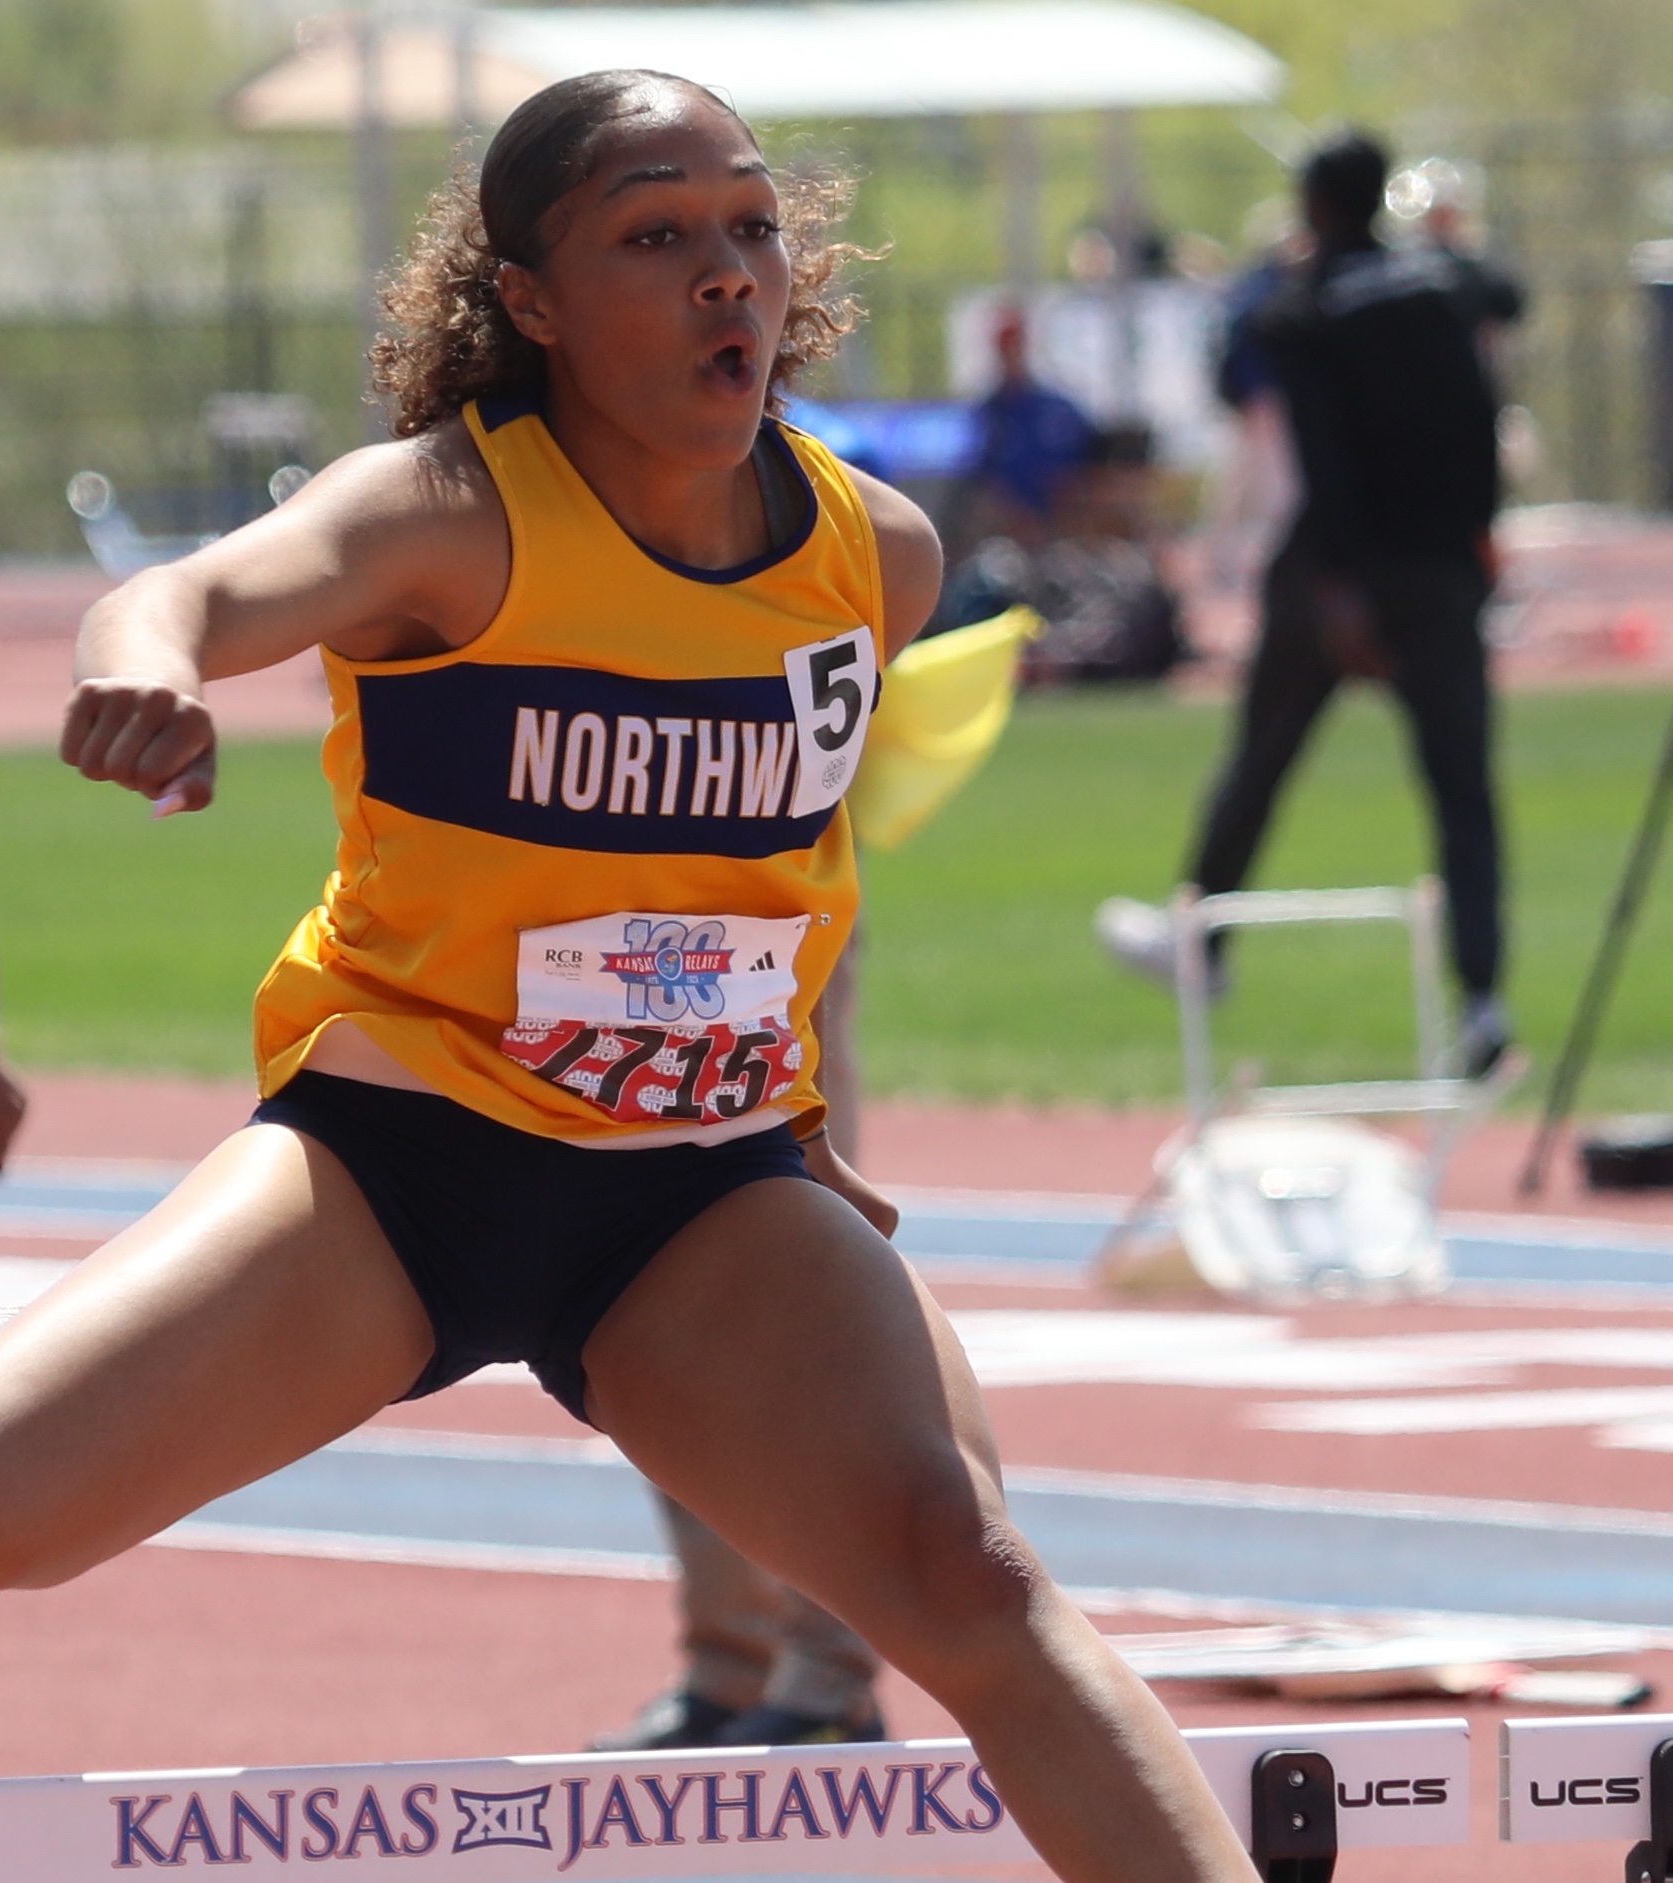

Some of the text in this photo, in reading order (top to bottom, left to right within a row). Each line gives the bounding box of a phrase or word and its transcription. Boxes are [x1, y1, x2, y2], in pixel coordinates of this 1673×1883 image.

[809, 640, 862, 752] 5
[507, 706, 801, 818] NORTHW
[545, 948, 583, 963] RCB
[685, 954, 721, 970] RELAYS
[1336, 1778, 1449, 1809] UCS
[1530, 1777, 1642, 1807] UCS
[109, 1782, 440, 1869] KANSAS
[557, 1761, 1004, 1873] JAYHAWKS
